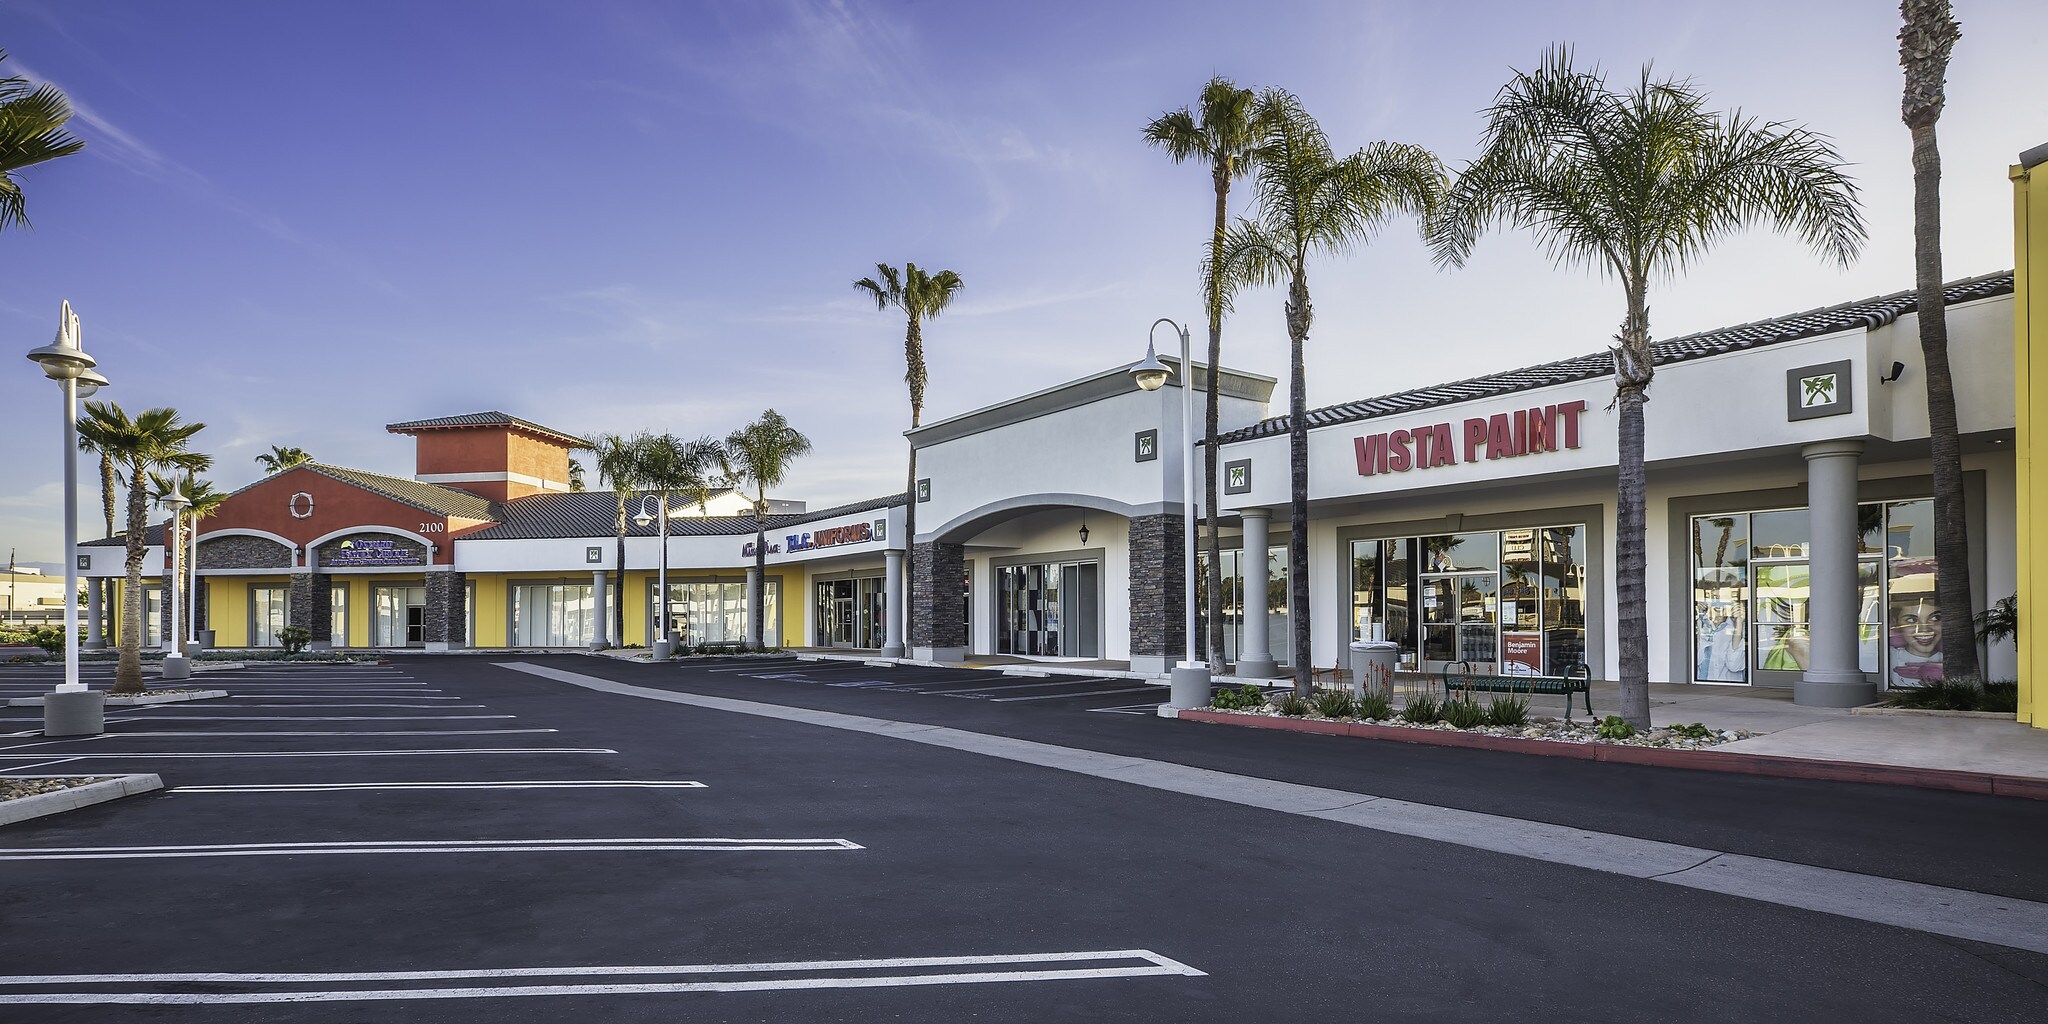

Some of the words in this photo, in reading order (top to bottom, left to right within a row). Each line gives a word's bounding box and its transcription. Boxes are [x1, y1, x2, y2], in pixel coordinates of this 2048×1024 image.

[1353, 422, 1457, 476] VISTA
[1463, 399, 1589, 463] PAINT
[419, 522, 444, 533] 2100
[814, 522, 871, 547] UNIFORMS
